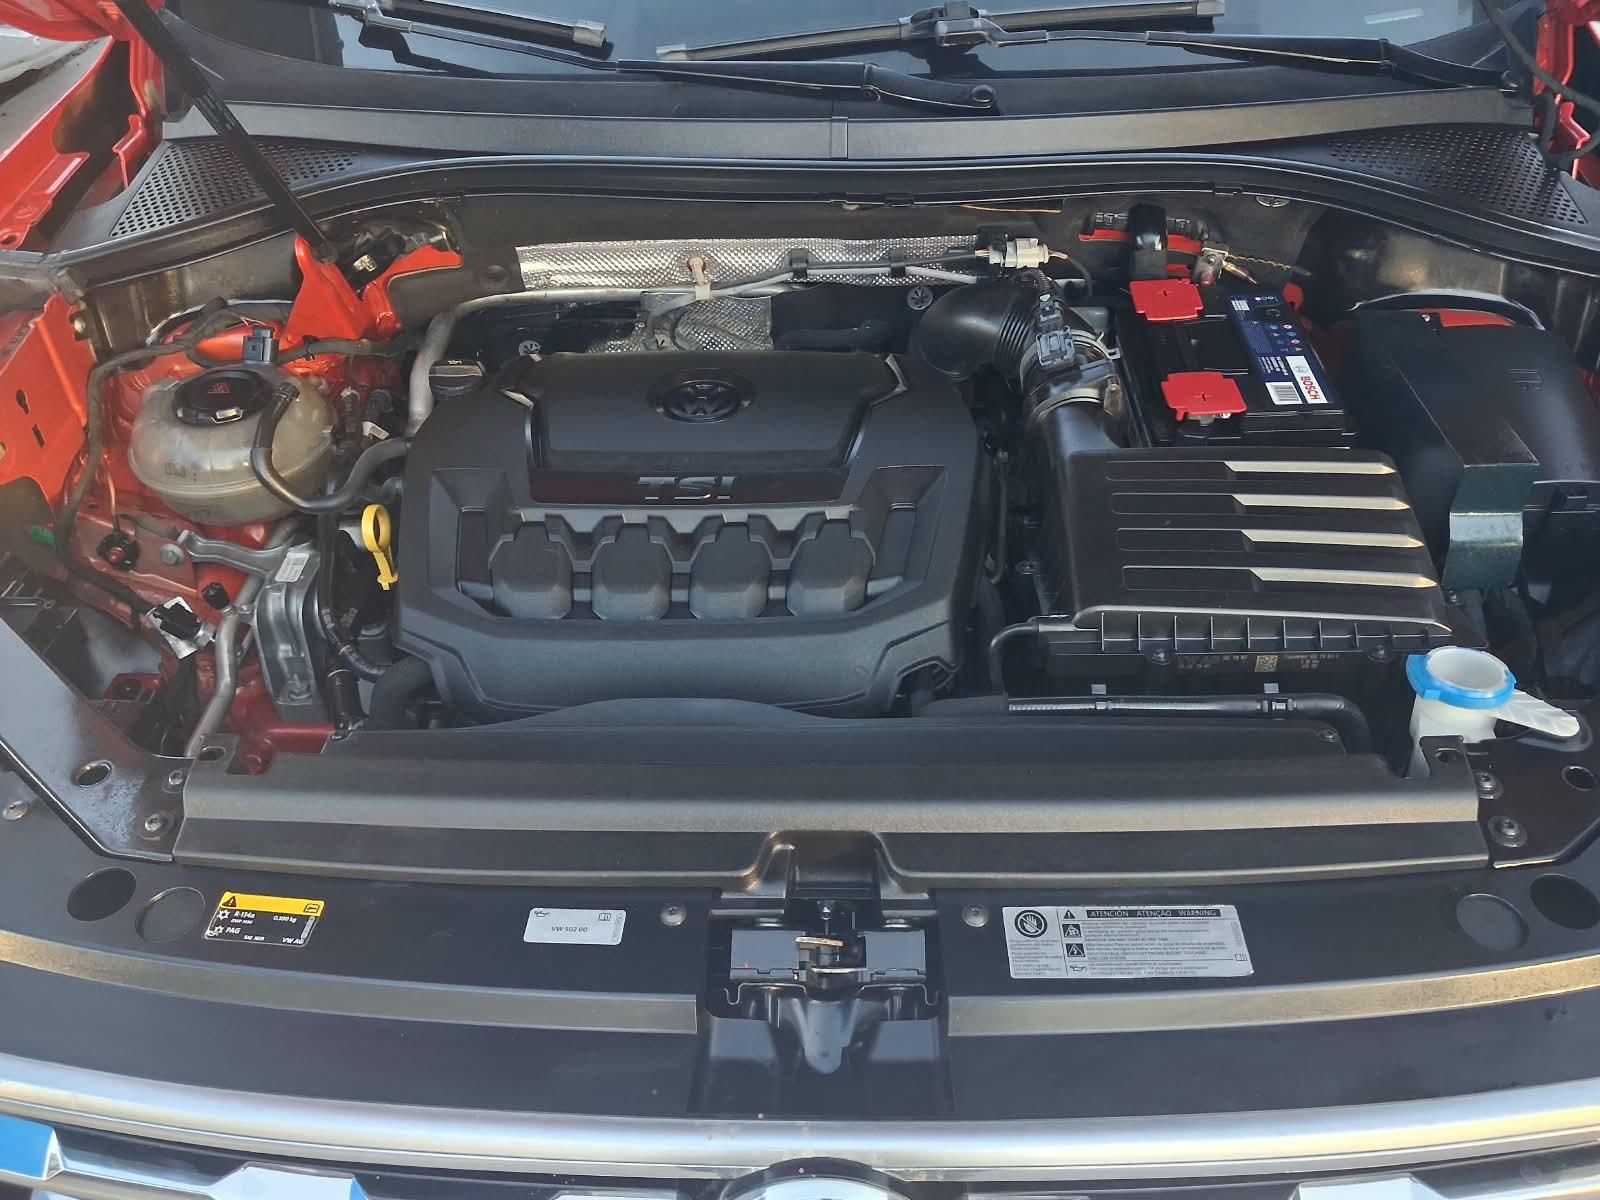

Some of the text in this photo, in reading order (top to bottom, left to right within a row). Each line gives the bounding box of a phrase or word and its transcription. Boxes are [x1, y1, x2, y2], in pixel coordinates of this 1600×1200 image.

[1300, 375, 1321, 400] BOSCH
[638, 475, 737, 500] TSI
[233, 911, 255, 919] R-134a
[1178, 909, 1217, 917] WARNING
[564, 925, 578, 933] 502
